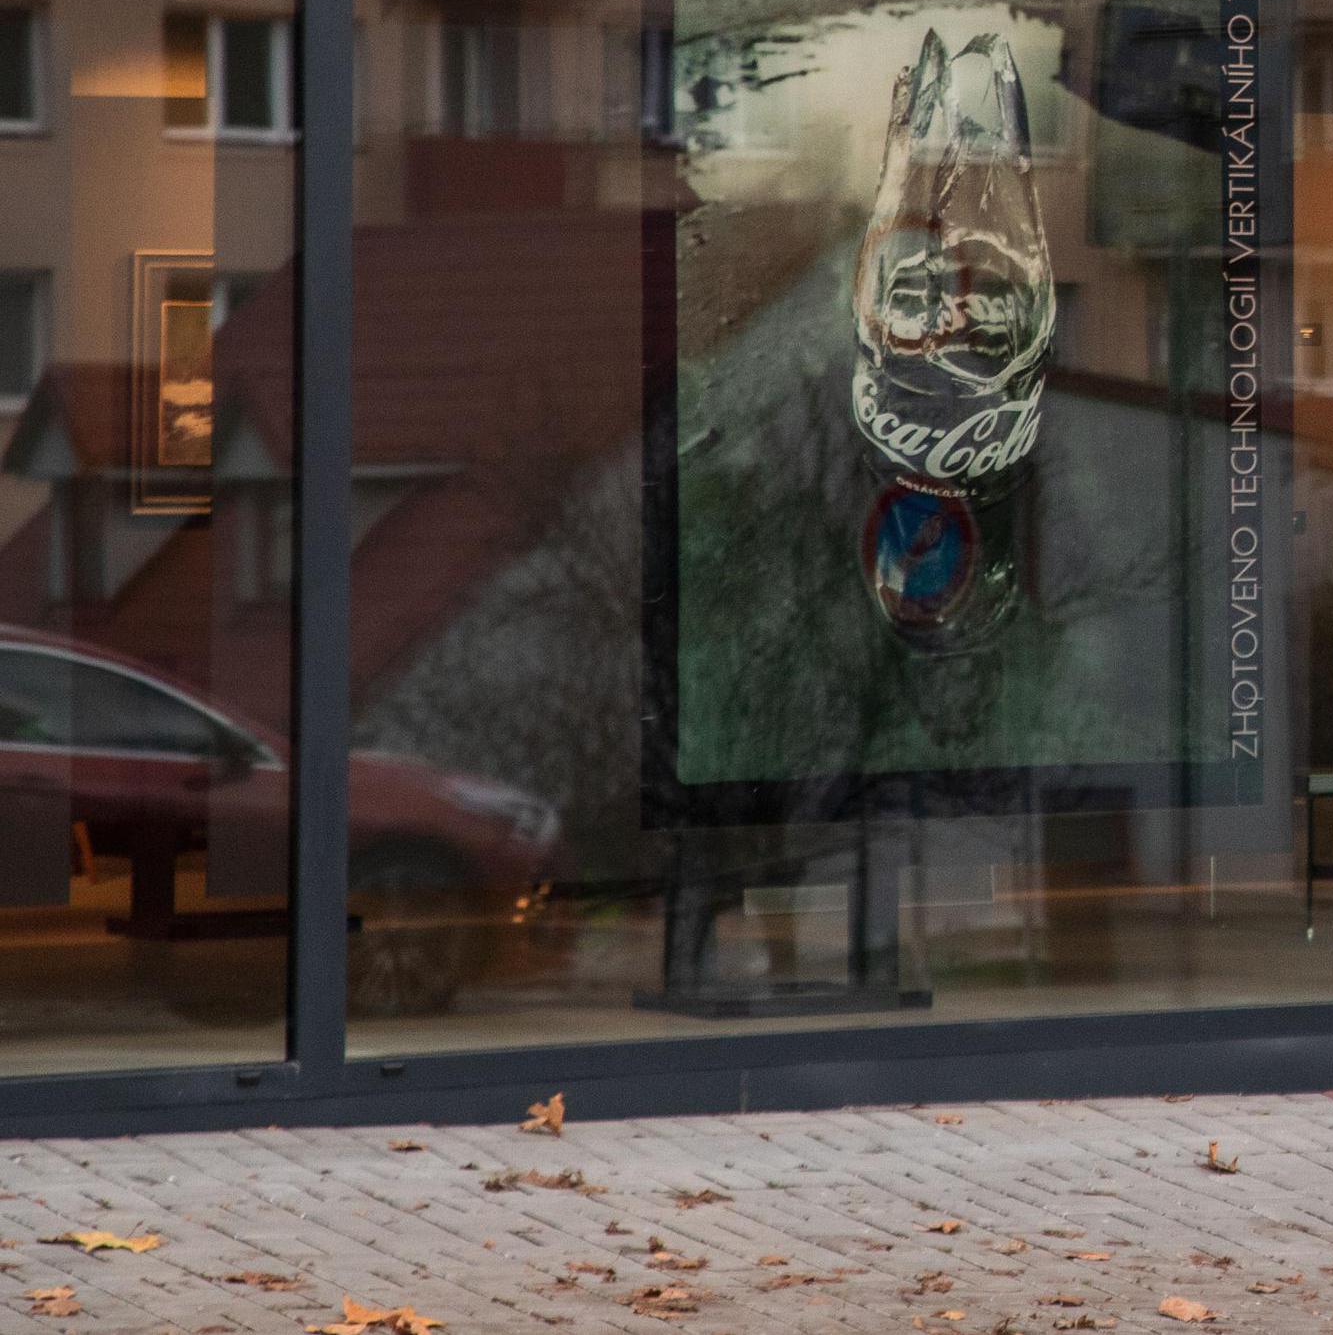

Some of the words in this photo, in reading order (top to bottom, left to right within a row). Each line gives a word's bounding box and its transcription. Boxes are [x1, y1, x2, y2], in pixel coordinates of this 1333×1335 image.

[1221, 14, 1255, 263] VERTIKÁLNÍHO
[1223, 271, 1257, 514] TECHNOLOGIÍ
[1230, 527, 1258, 760] ZHOTOVENO
